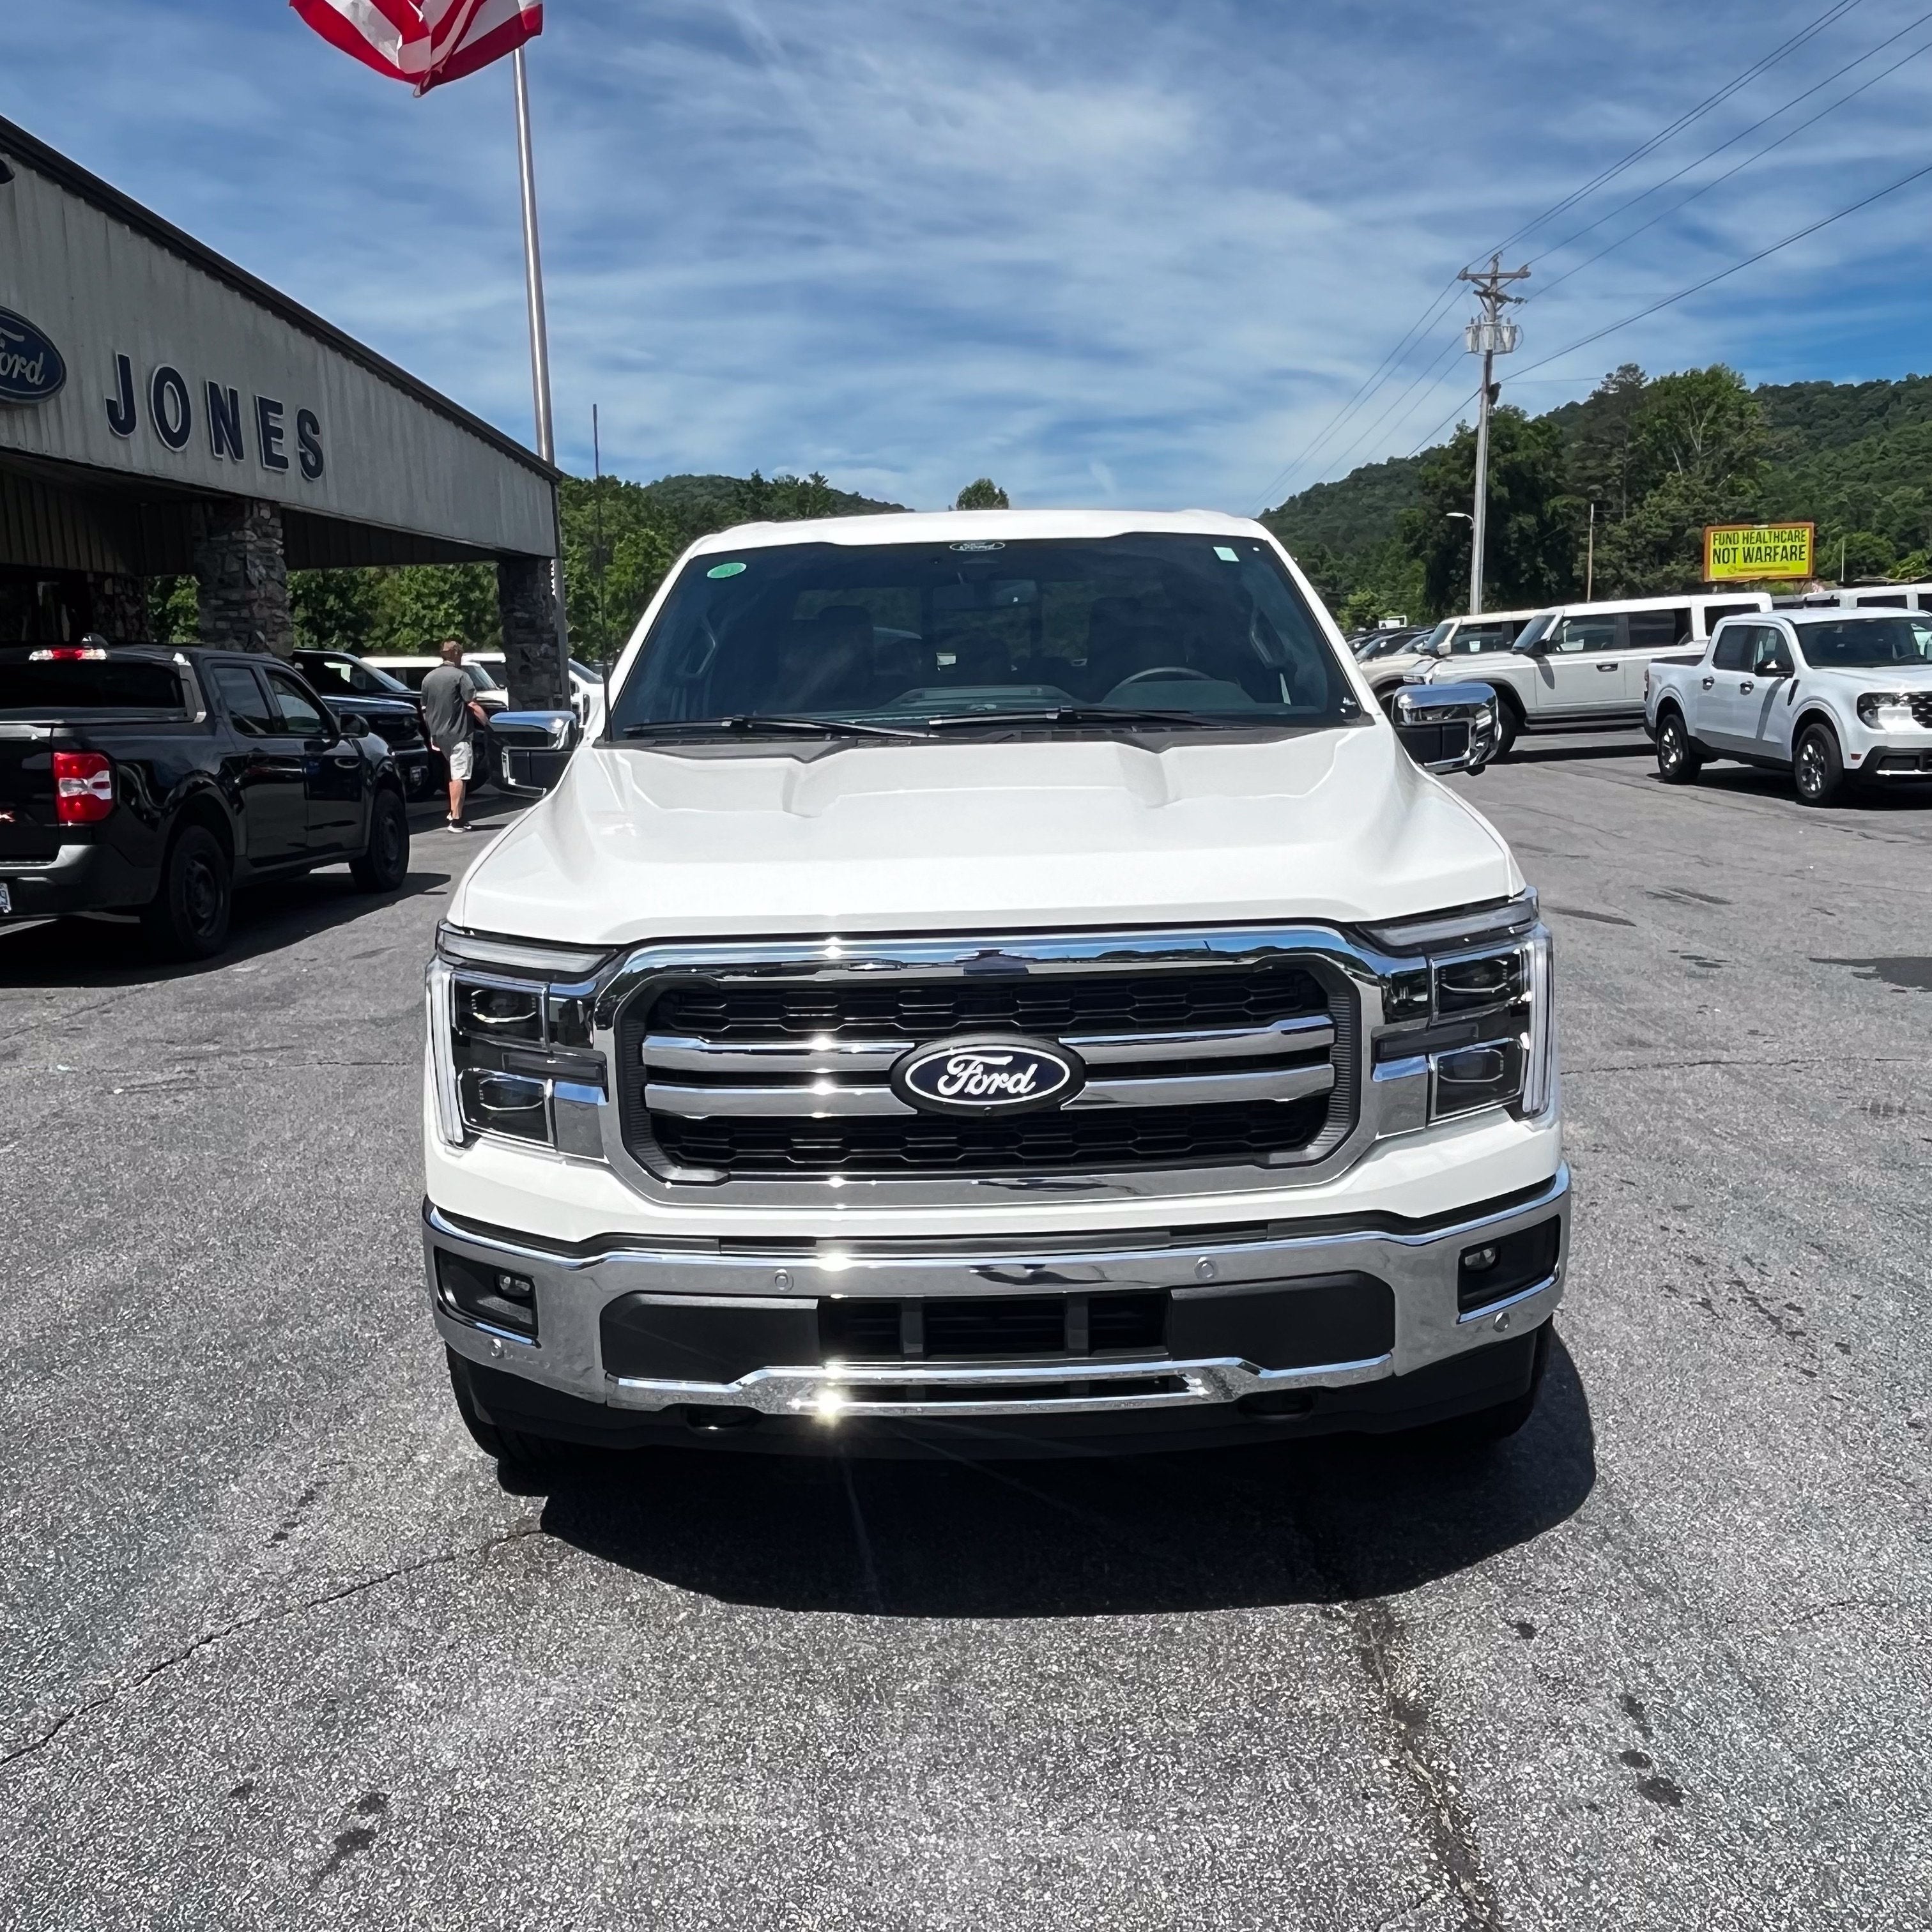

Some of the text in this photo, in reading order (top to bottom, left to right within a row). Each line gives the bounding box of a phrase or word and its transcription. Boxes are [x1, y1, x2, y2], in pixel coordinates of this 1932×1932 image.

[105, 351, 324, 480] JONES
[1713, 530, 1806, 546] FUND HEALTHCARE
[1712, 545, 1806, 564] NOT WARFARE
[937, 1055, 1038, 1095] Ford
